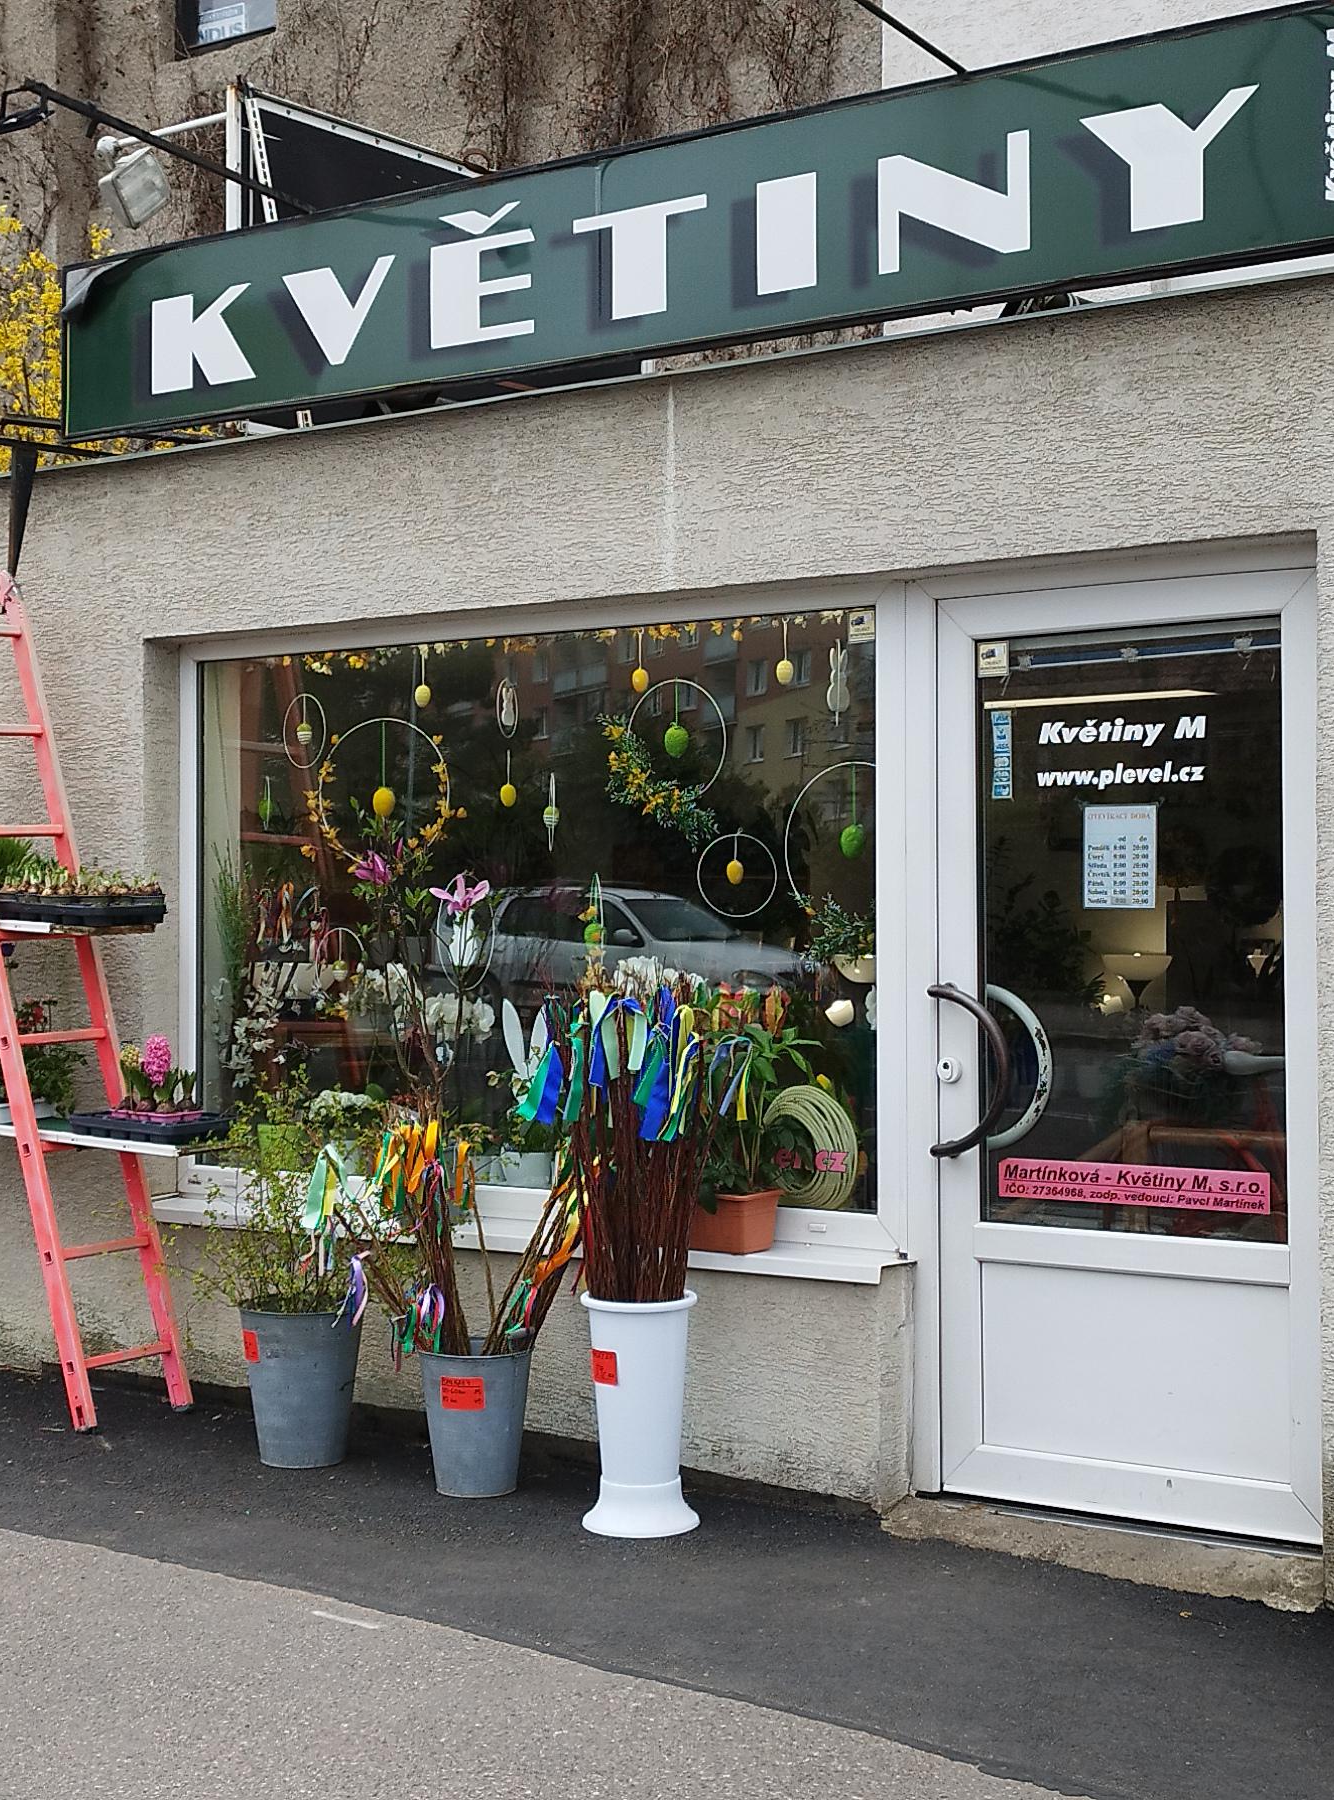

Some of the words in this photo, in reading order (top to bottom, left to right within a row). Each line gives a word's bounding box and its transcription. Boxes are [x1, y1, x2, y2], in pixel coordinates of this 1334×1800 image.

[150, 83, 1260, 395] KVĚTINY
[1038, 718, 1165, 747] Květiny
[1173, 715, 1207, 740] M
[1036, 760, 1206, 790] www.plevel.cz
[1003, 1164, 1100, 1184] Martínková
[1116, 1169, 1187, 1192] Květiny
[1191, 1175, 1213, 1192] M,
[1219, 1179, 1265, 1194] s.r.o.
[1005, 1183, 1029, 1194] IČO:
[1032, 1185, 1087, 1199] 27364968,
[1089, 1190, 1121, 1202] zodp.
[1177, 1194, 1210, 1206] Pavel
[1212, 1197, 1266, 1210] Martínek
